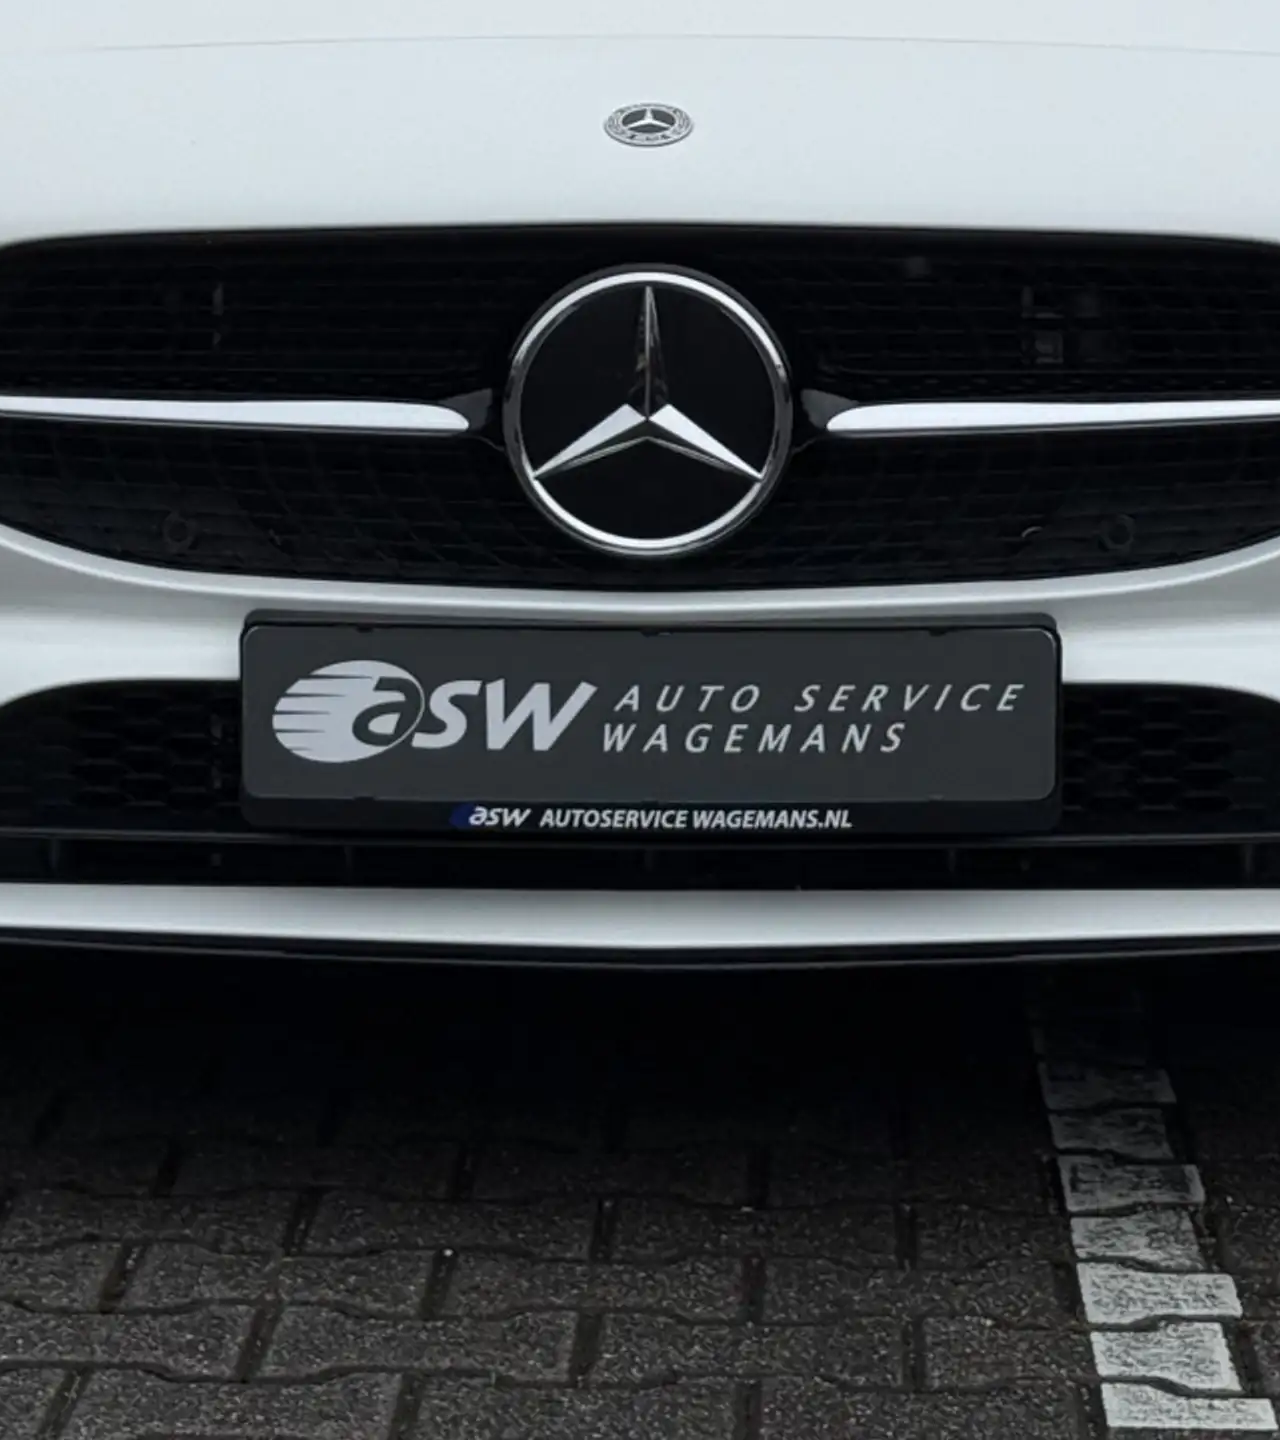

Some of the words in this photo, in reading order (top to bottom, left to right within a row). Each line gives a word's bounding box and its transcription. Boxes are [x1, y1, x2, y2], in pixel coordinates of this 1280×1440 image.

[614, 684, 761, 713] AUTO
[794, 683, 1024, 712] SERVICE
[602, 722, 906, 754] WAGEMANS
[539, 808, 689, 829] AUTOSERVICE
[692, 808, 853, 830] WAGEMANS.NL
